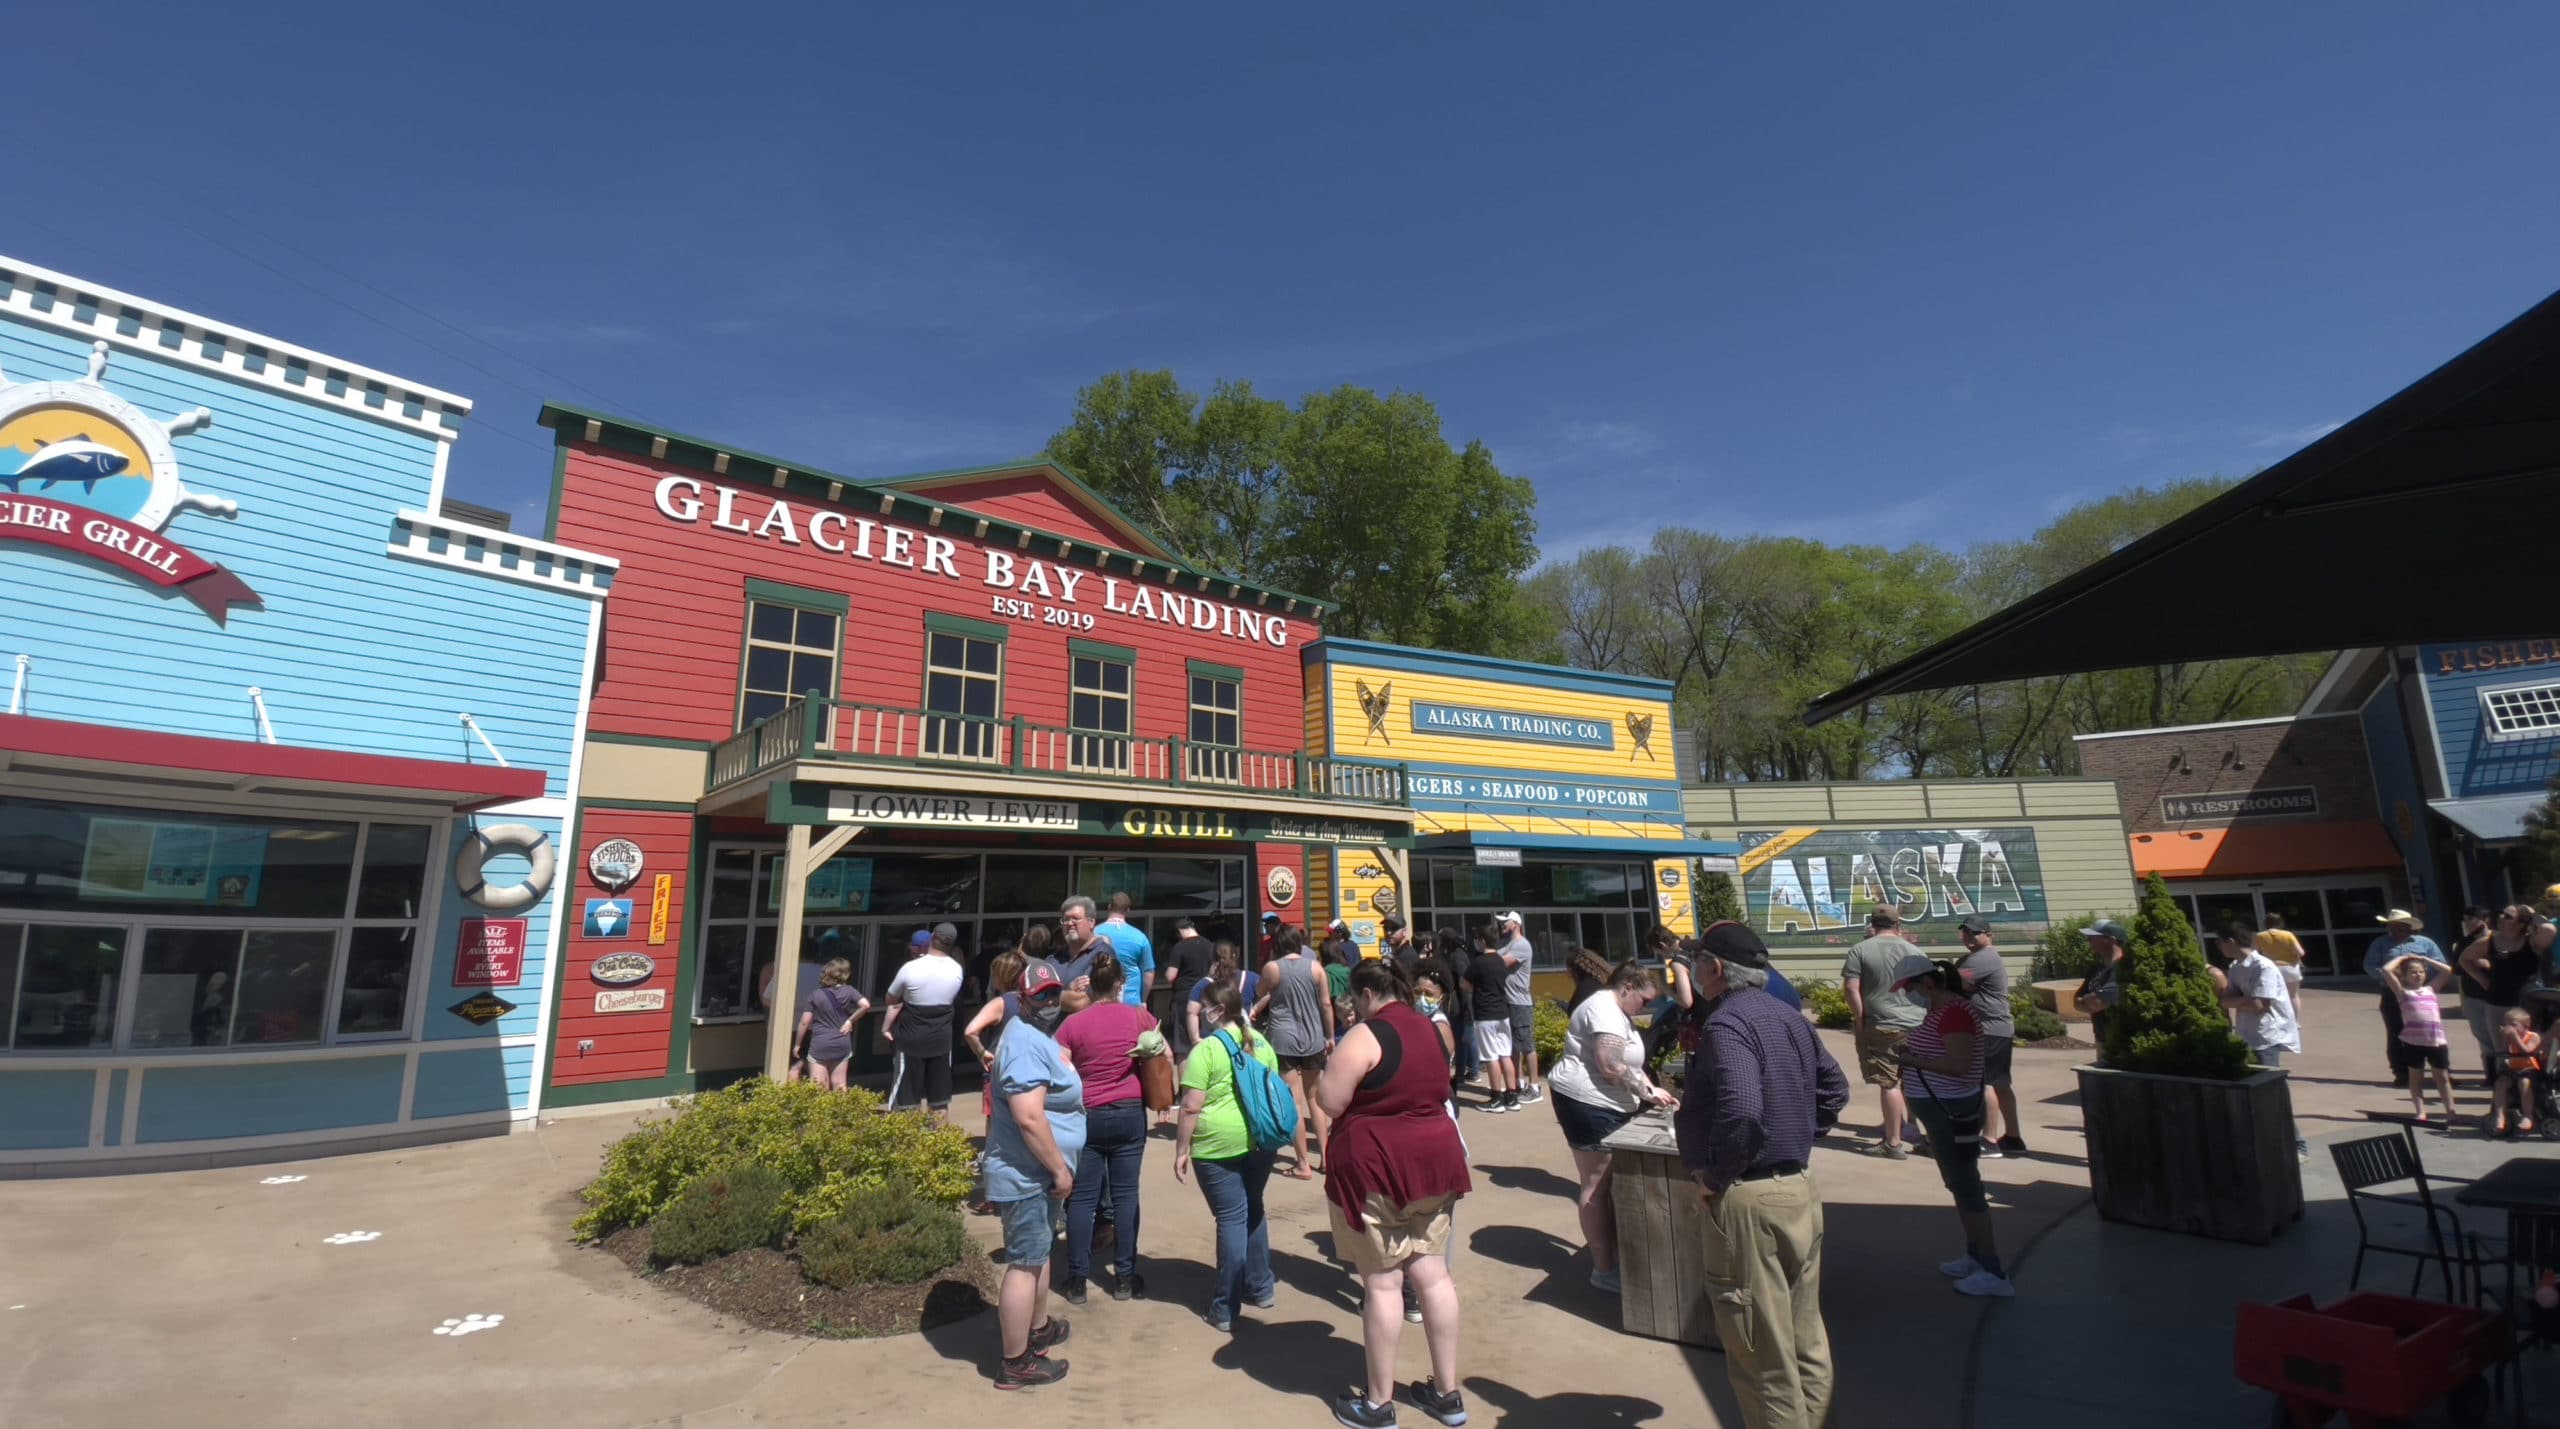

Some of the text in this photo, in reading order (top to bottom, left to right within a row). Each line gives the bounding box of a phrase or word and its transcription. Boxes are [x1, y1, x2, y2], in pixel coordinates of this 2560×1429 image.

[83, 519, 181, 576] GRILL
[655, 476, 1287, 647] GLACIER BAY LANDING
[992, 595, 1095, 632] EST. 2019
[1428, 708, 1602, 740] ALASKA TRADING CO.
[1482, 781, 1558, 802] SEAFOOD
[1575, 787, 1649, 807] POPCORN
[2191, 794, 2312, 814] RESTROOMS
[850, 793, 1076, 826] LOWER LEVEL
[1123, 807, 1233, 838] GRILL
[1270, 816, 1385, 844] Order at Any Window
[596, 842, 631, 863] FISHING
[608, 850, 636, 864] TOURS
[1767, 840, 2025, 933] ALASKA
[653, 876, 667, 936] FRIES
[466, 946, 515, 956] AVAILABLE
[478, 938, 506, 947] ITEMS
[468, 969, 509, 979] WINDOW
[474, 962, 504, 971] EVERY
[597, 956, 649, 975] Ice Cream
[598, 991, 664, 1010] Cheeseburger
